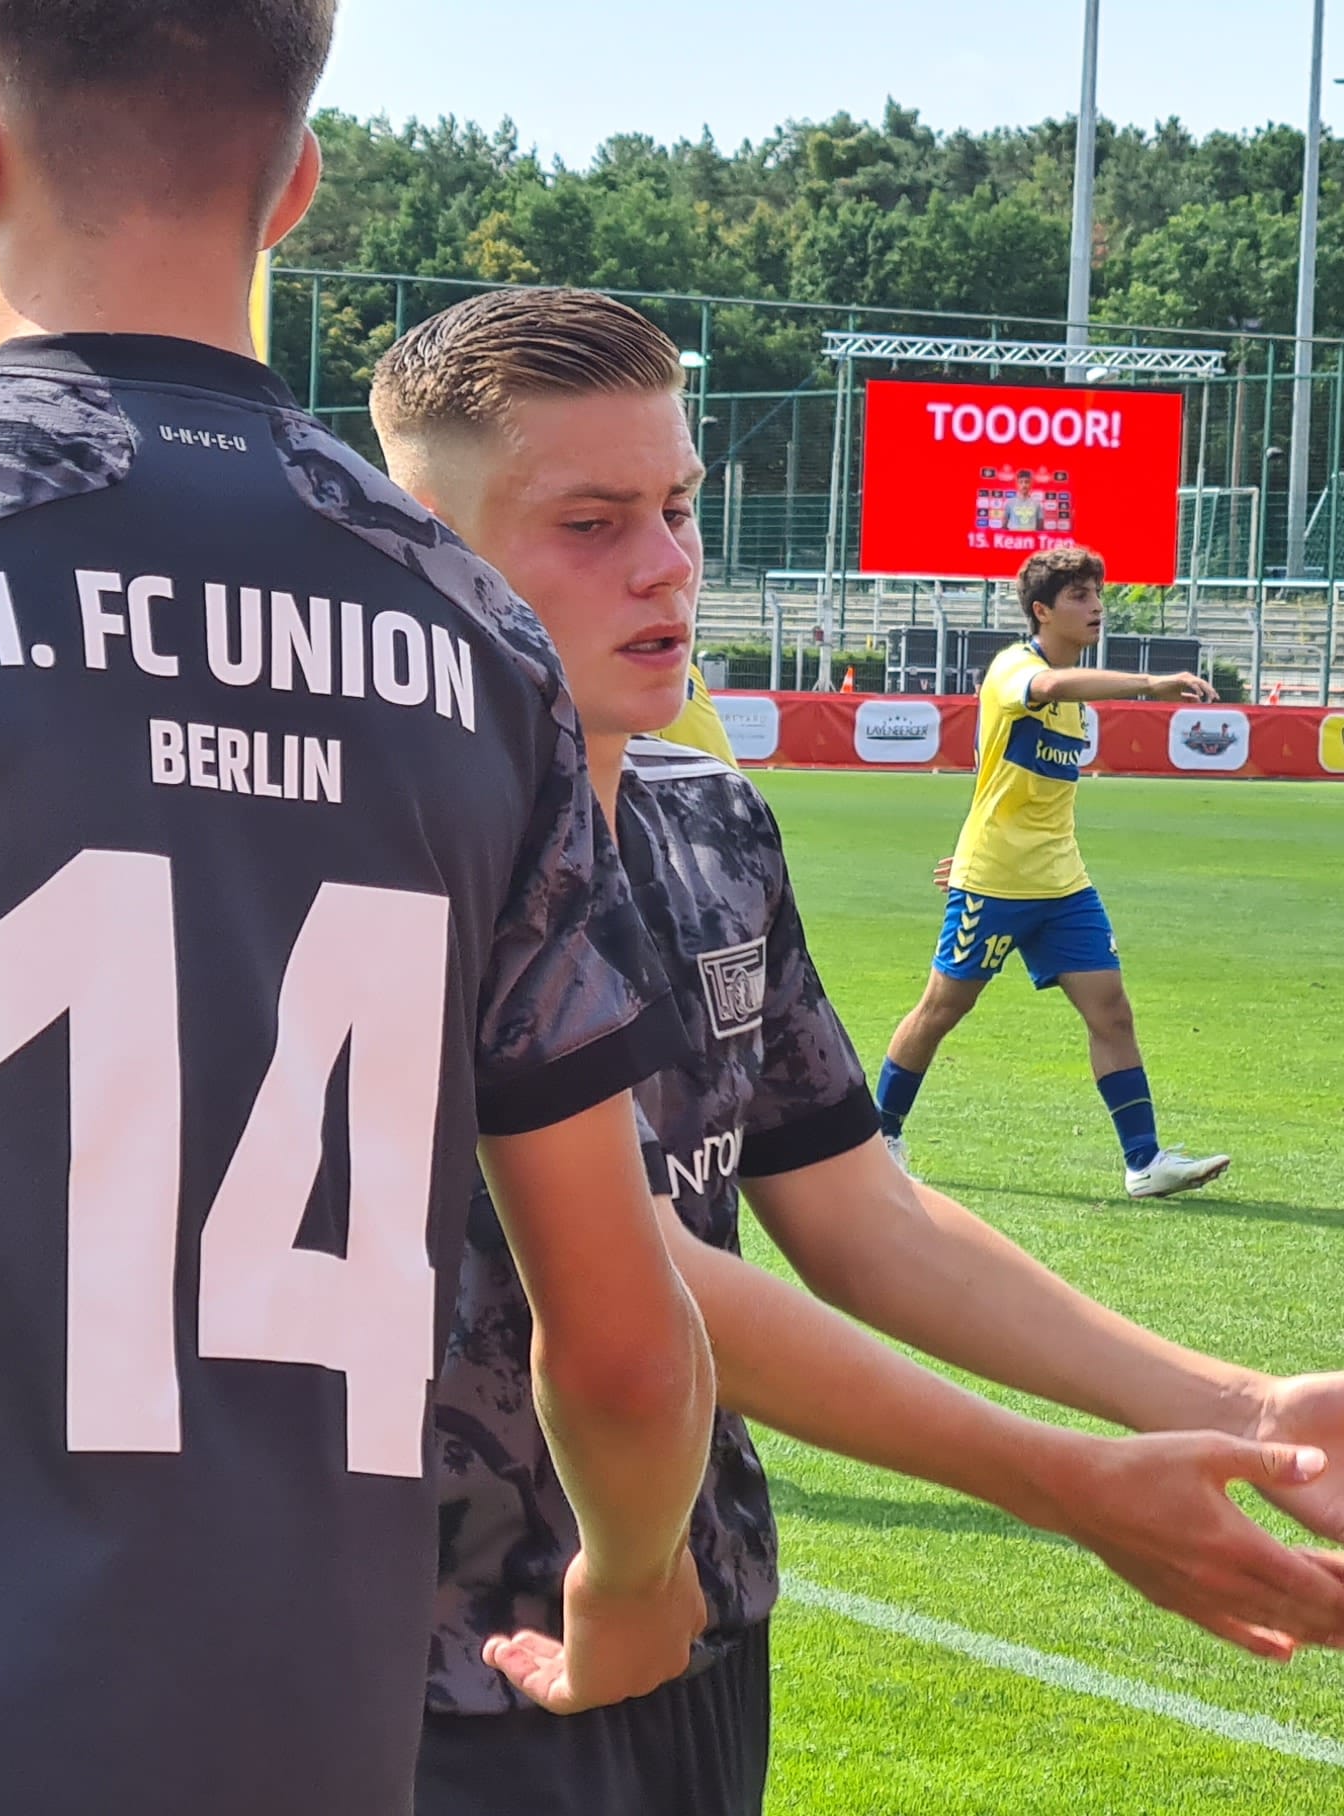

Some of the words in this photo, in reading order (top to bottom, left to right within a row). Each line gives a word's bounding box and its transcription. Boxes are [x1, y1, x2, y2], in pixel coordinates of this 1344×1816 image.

[926, 402, 1121, 448] TOOOOR!
[967, 532, 990, 548] 15.
[993, 533, 1035, 549] Kean
[75, 569, 179, 677] FC
[204, 582, 476, 733] UNION
[149, 718, 342, 804] BERLIN
[980, 934, 1013, 968] 19
